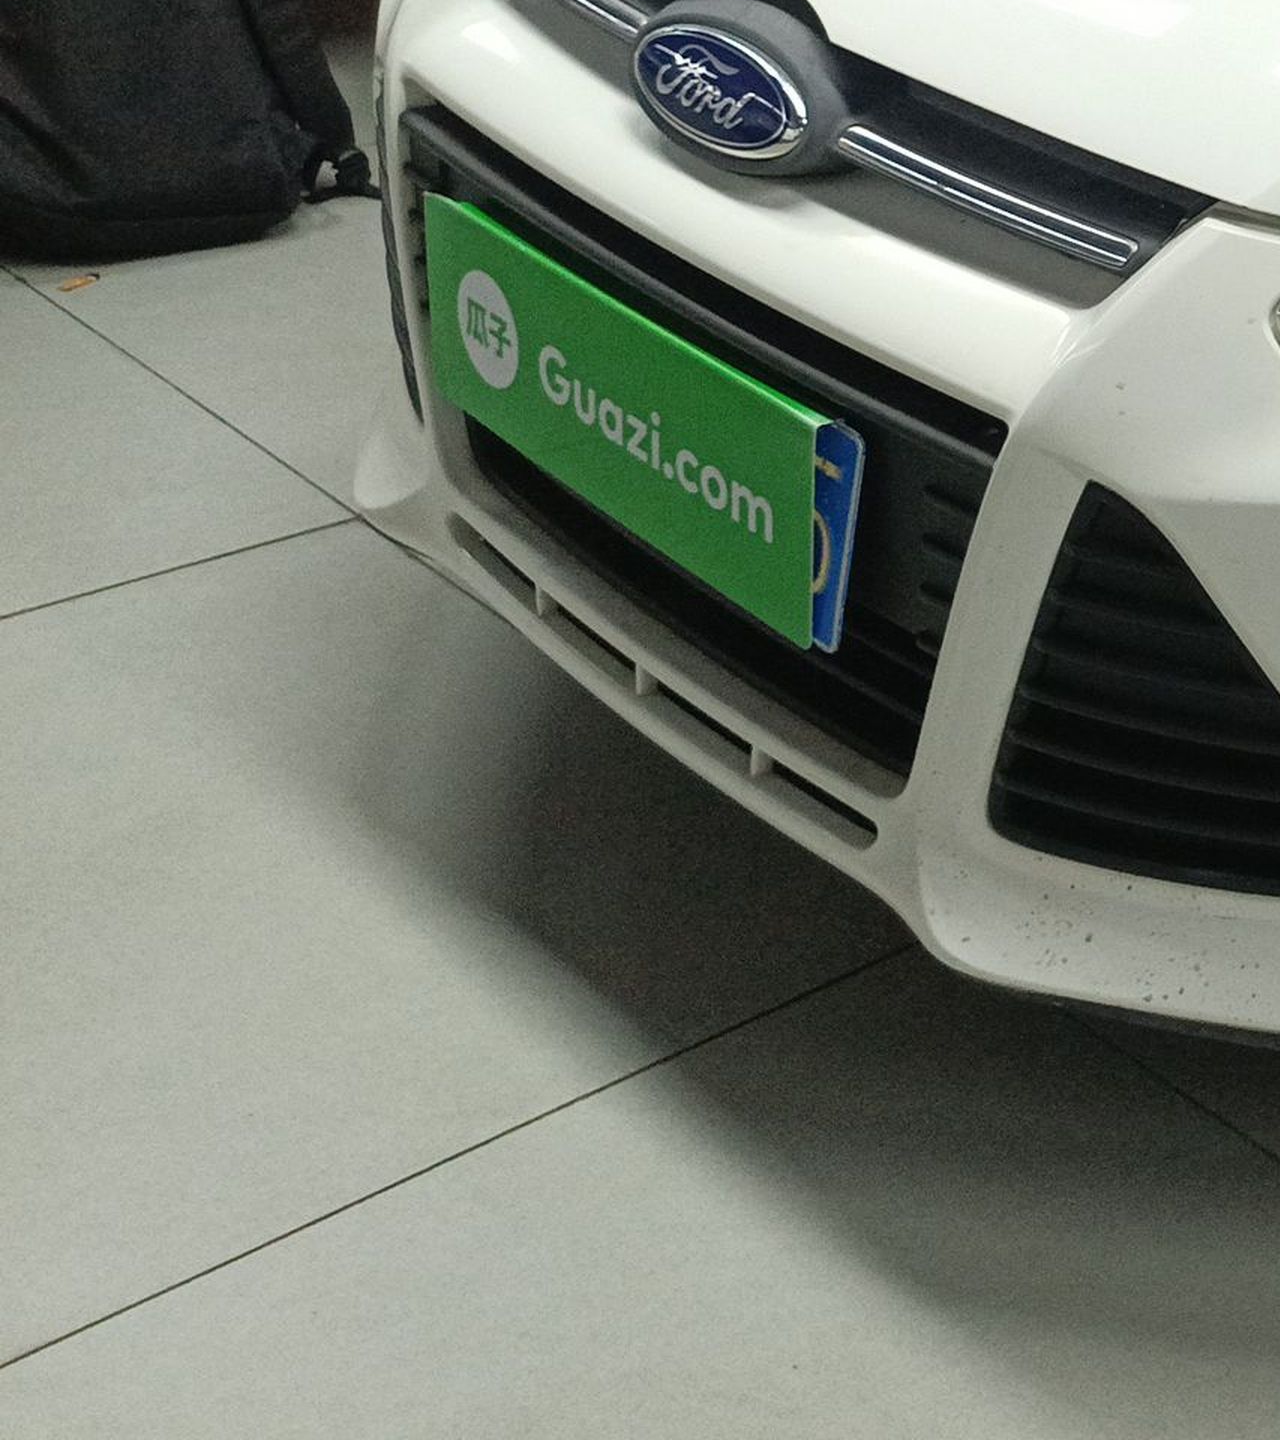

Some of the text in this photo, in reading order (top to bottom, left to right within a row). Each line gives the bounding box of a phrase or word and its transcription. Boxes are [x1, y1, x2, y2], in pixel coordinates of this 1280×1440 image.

[653, 43, 757, 130] Ford
[466, 296, 511, 359] 瓜子
[538, 344, 774, 544] Guazi.com
